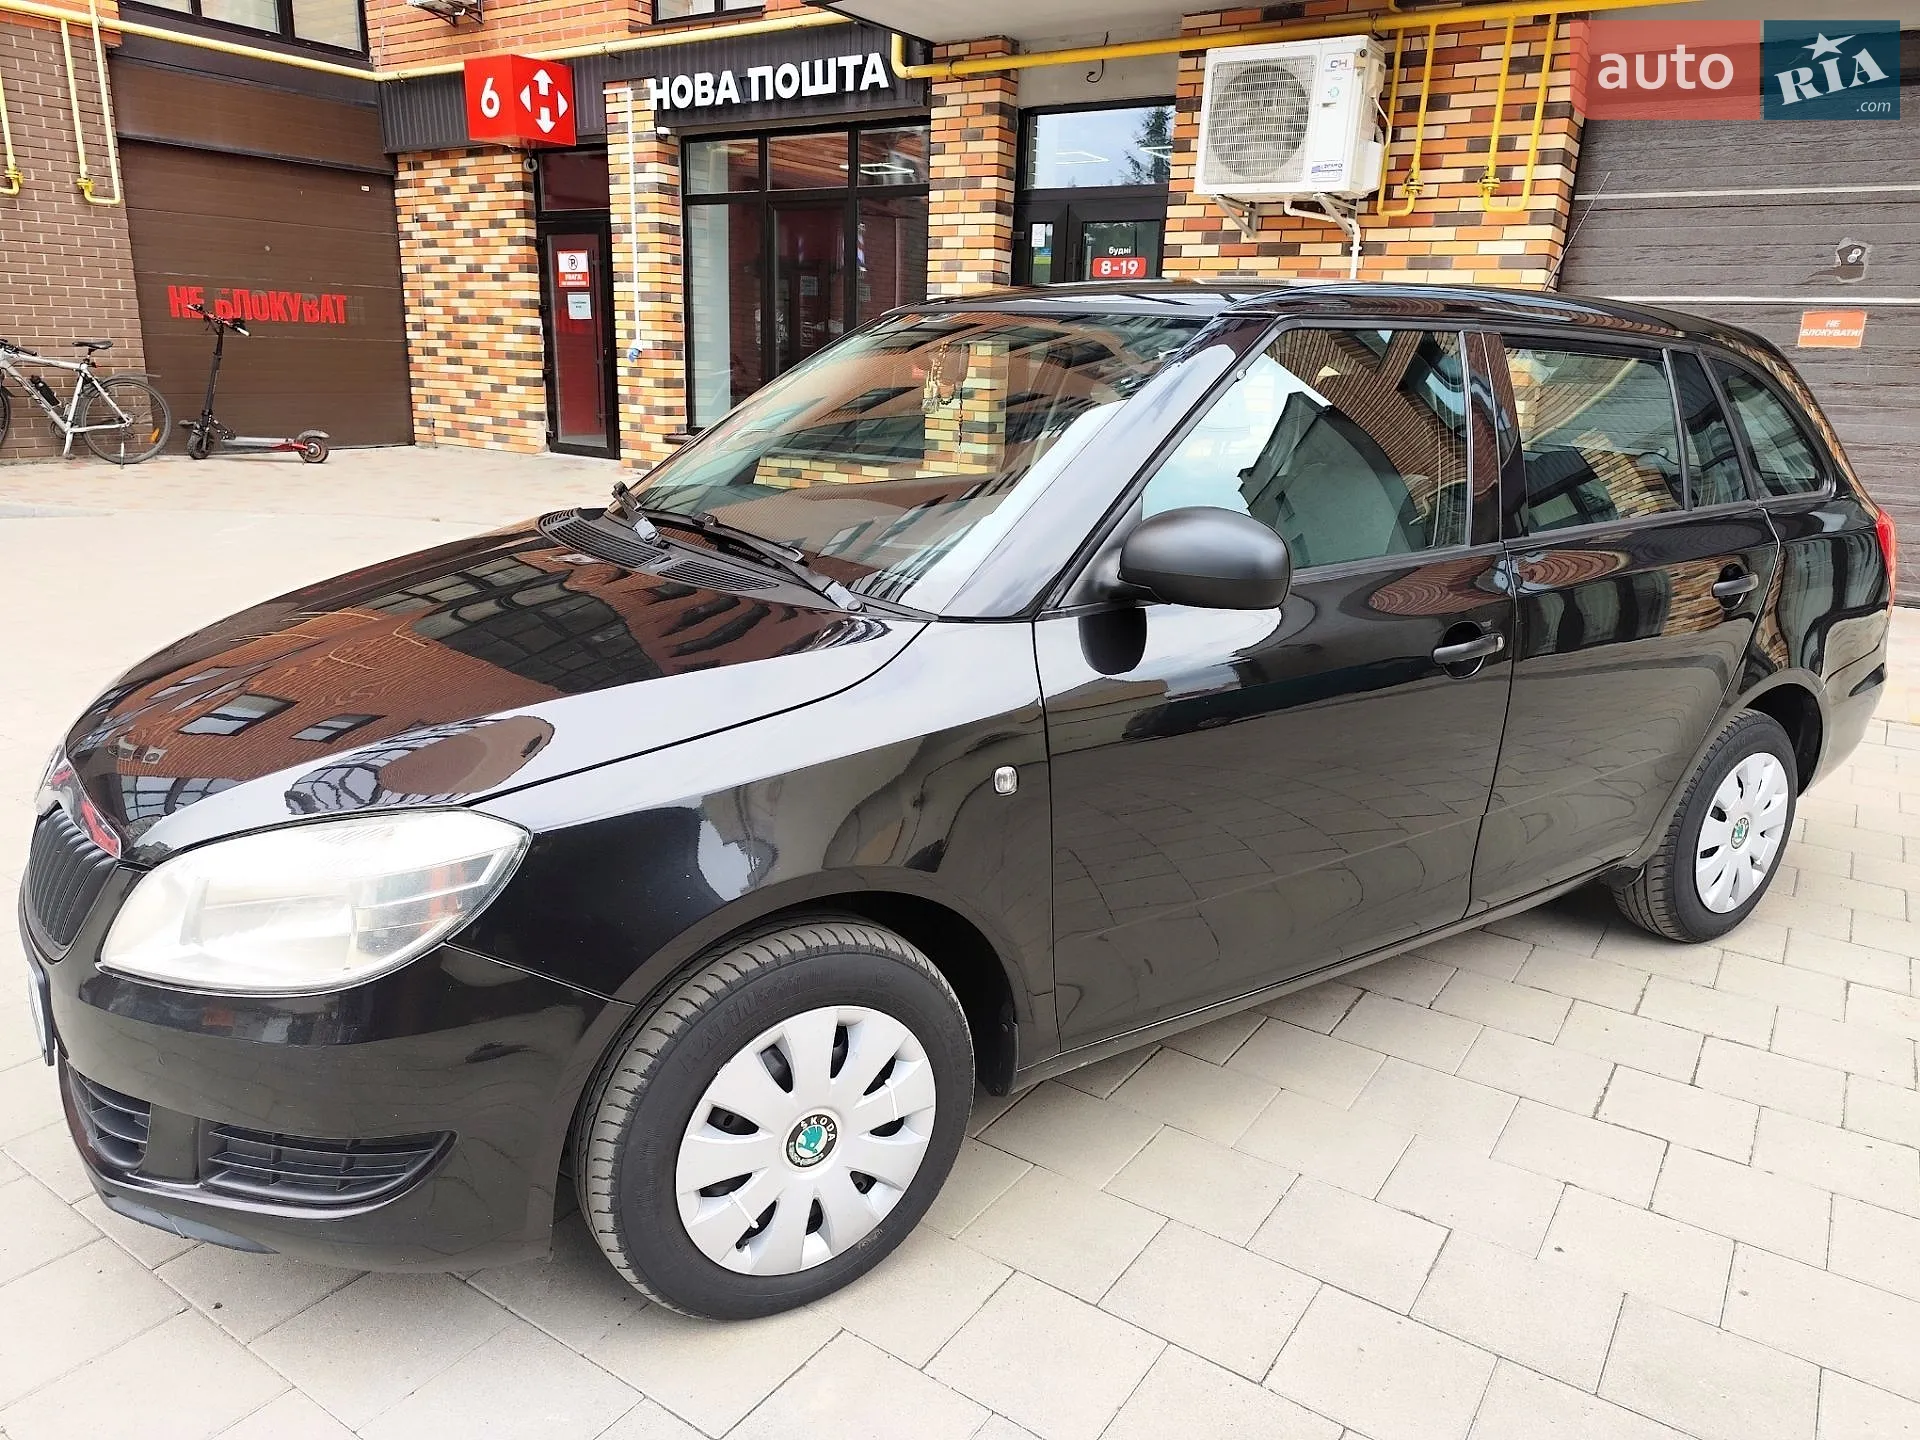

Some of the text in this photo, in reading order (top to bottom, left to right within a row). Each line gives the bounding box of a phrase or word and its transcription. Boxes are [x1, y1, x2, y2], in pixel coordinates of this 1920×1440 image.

[481, 77, 500, 118] 6
[649, 52, 889, 111] НОВА ПОШТА
[1100, 260, 1139, 275] 8-19
[1108, 246, 1131, 256] будні
[168, 285, 205, 319] НЕ
